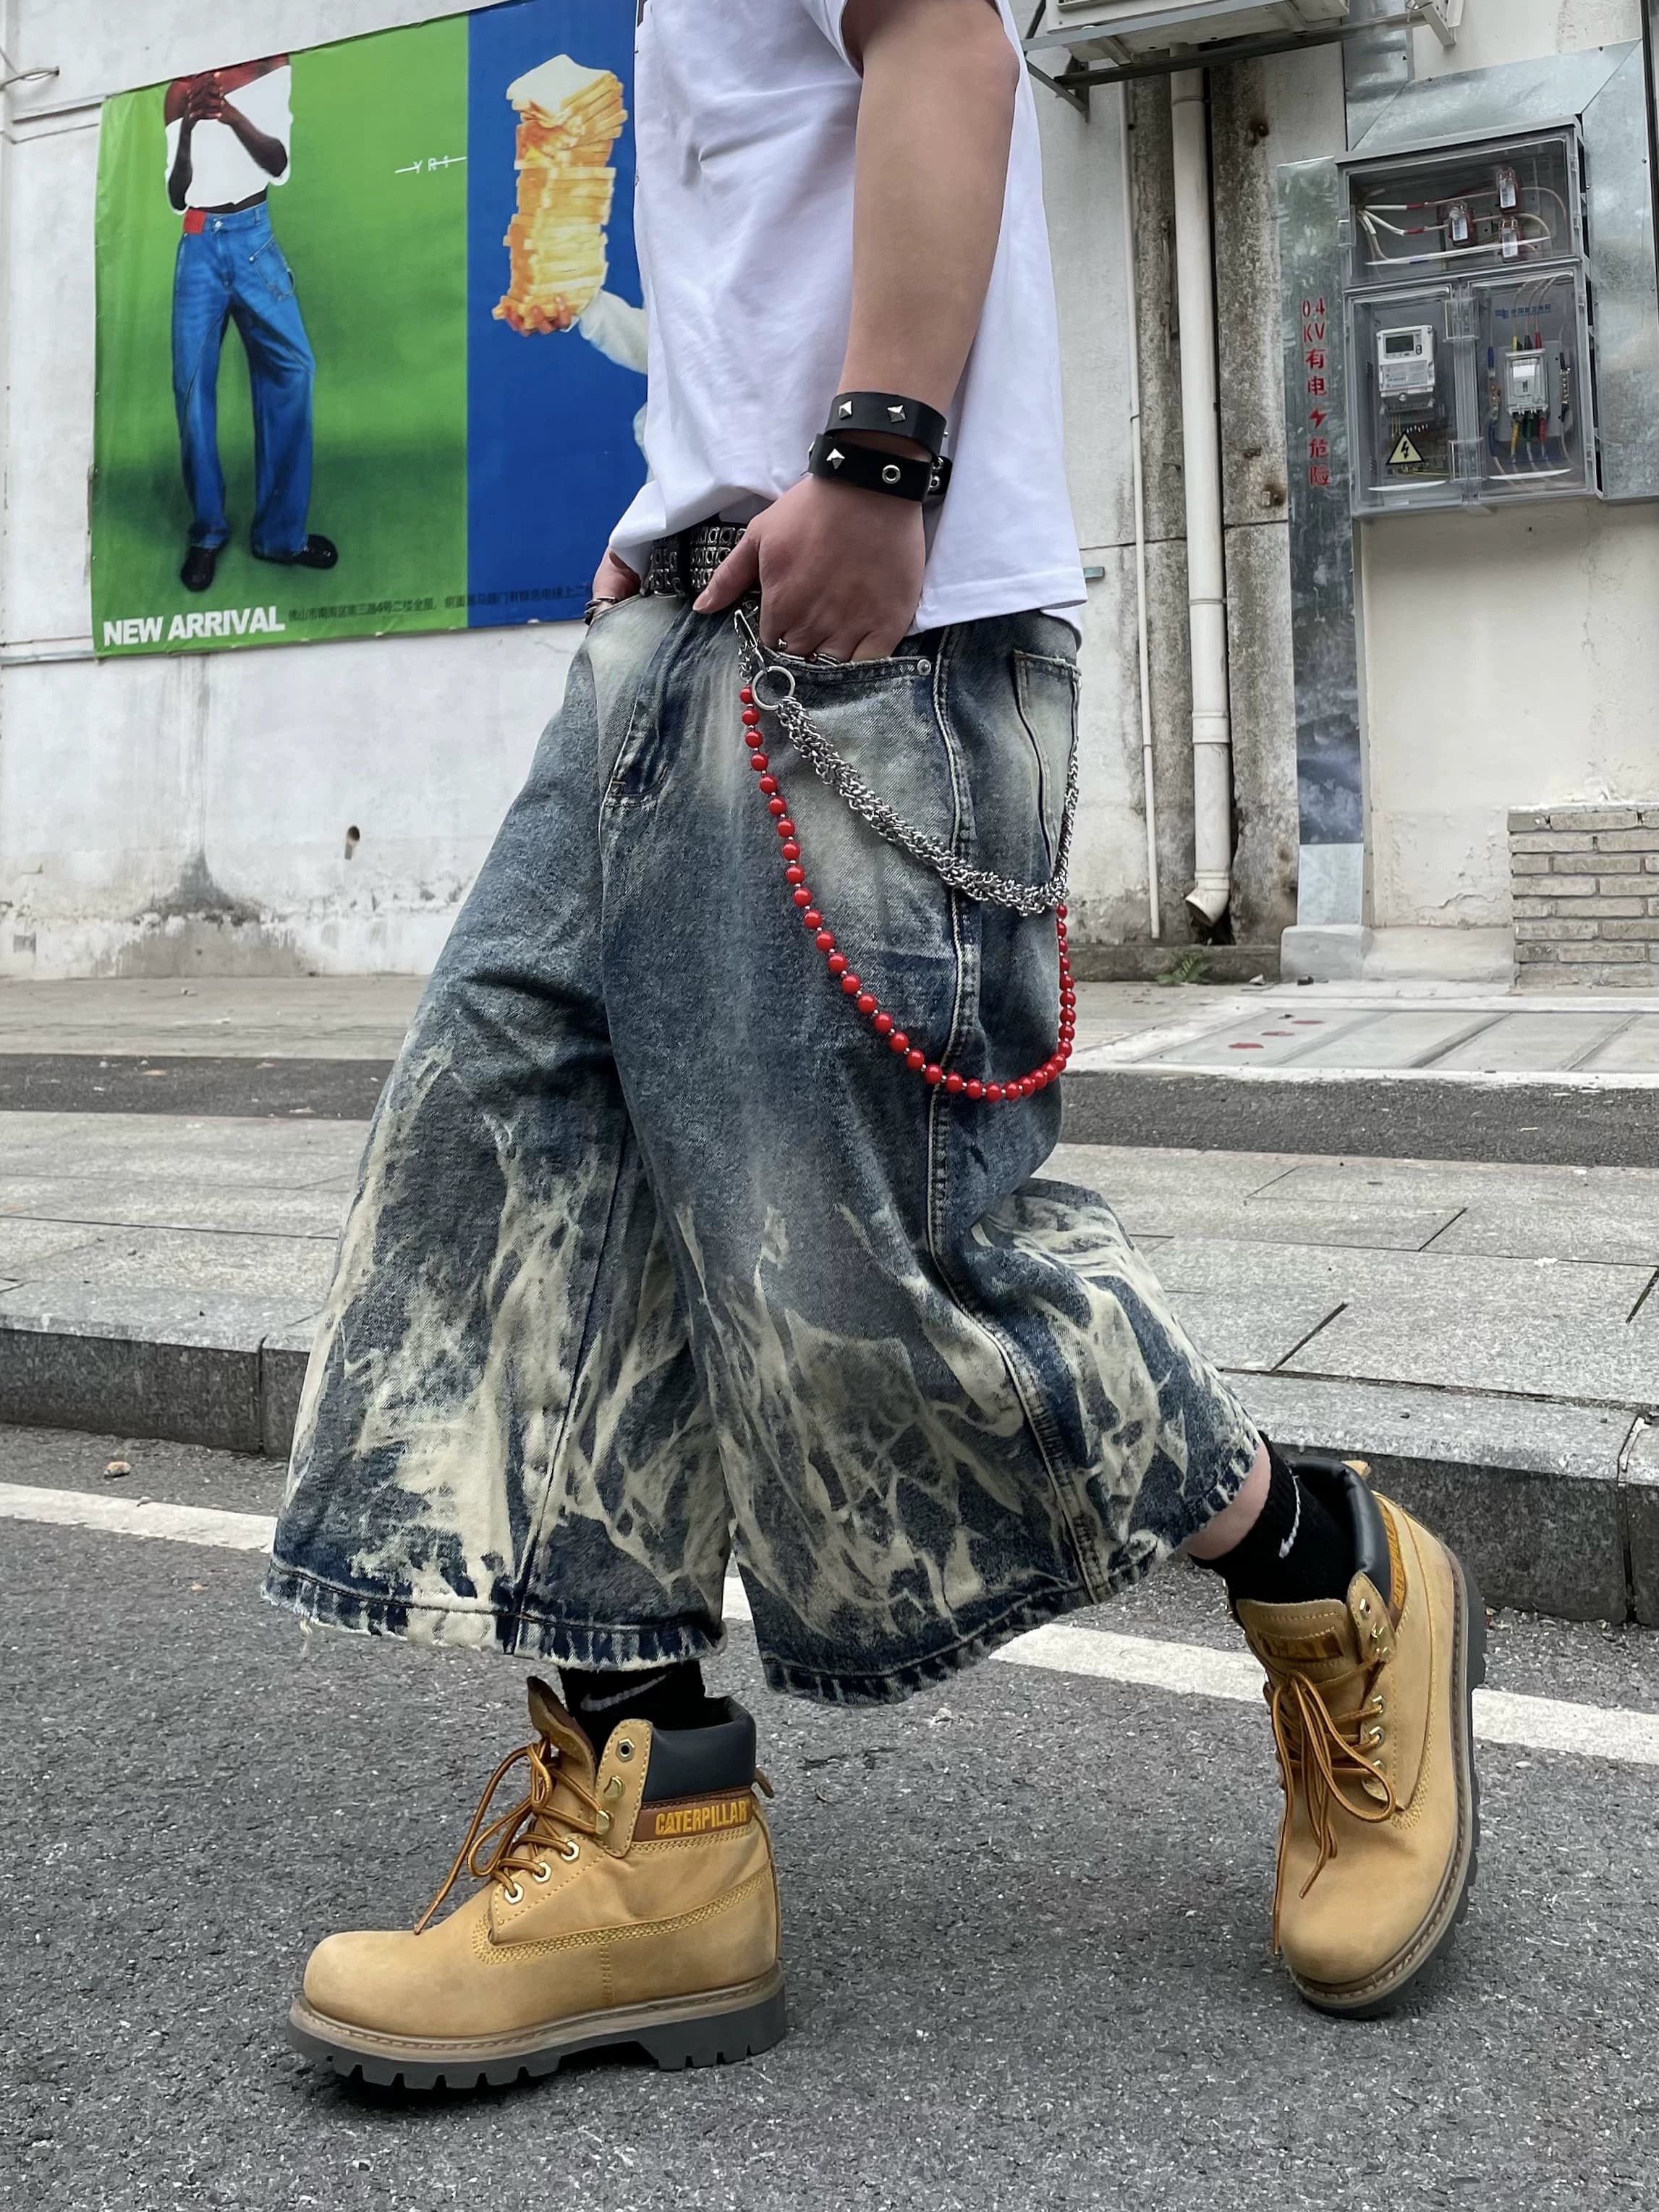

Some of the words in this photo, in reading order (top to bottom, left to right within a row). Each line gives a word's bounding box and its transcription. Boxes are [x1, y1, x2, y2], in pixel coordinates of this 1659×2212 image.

[1304, 322, 1325, 342] KV
[103, 616, 164, 646] NEW
[167, 606, 286, 641] ARRIVAL
[655, 1800, 748, 1836] CATERPILLAR
